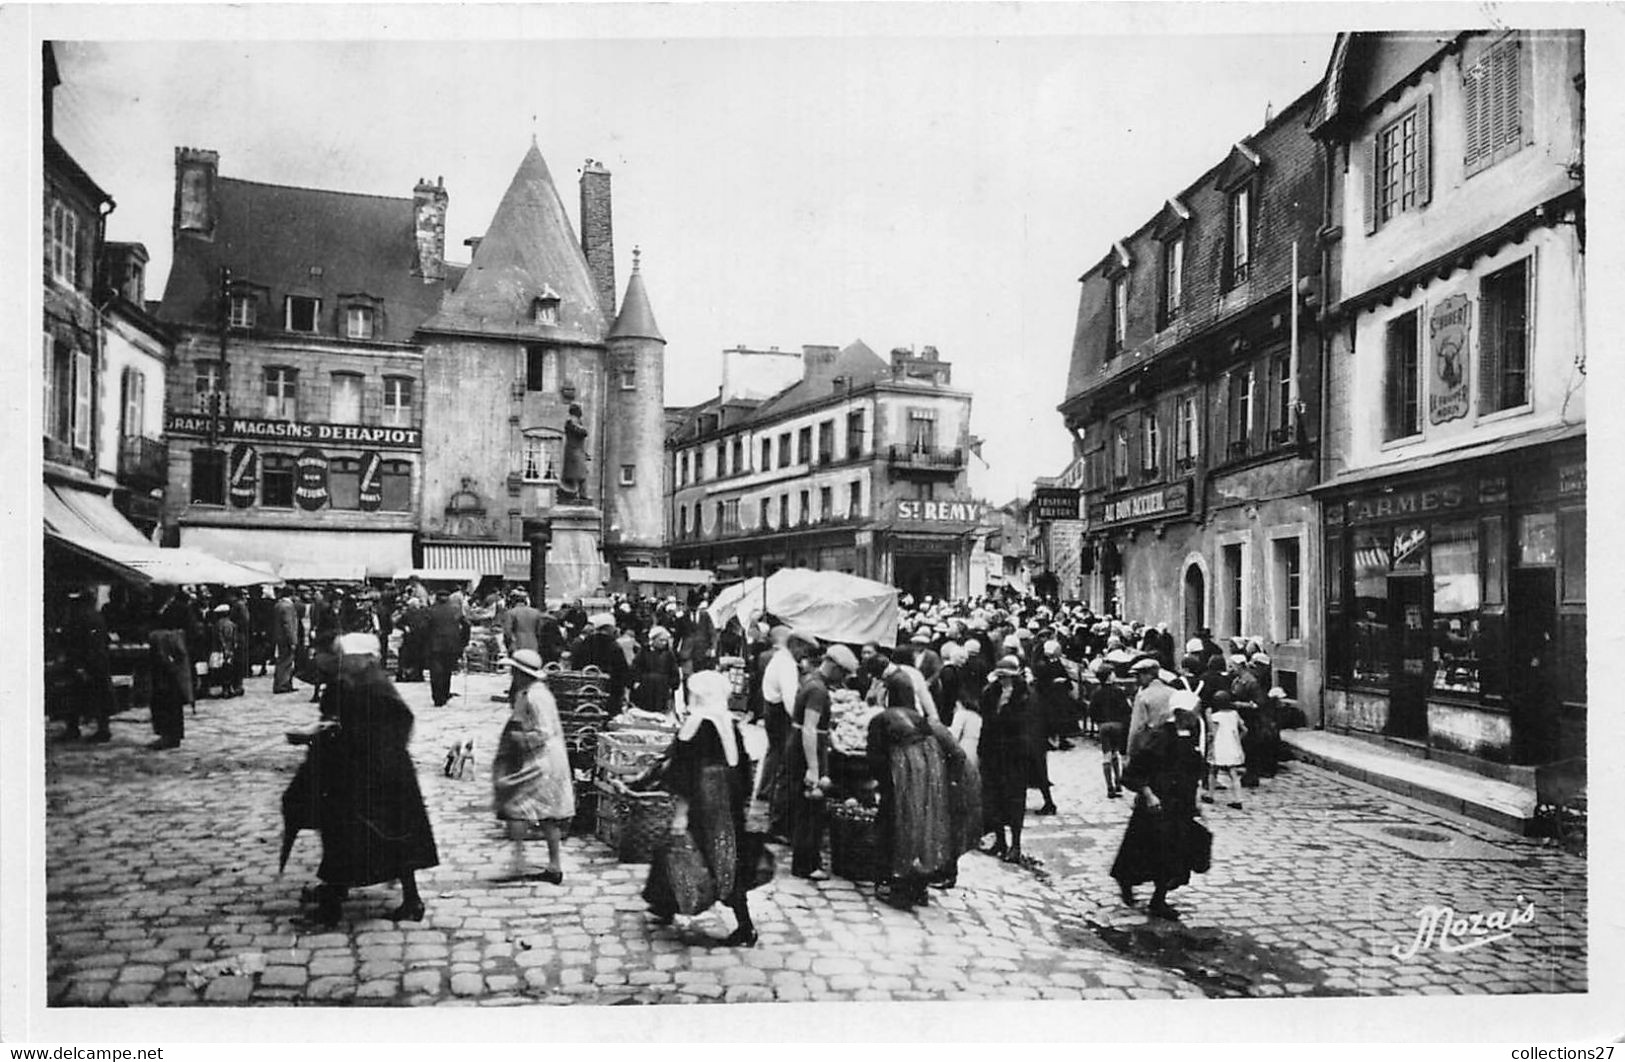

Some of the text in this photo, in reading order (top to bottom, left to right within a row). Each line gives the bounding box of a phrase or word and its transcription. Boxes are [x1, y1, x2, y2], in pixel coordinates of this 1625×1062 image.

[233, 420, 312, 439] MAGASINS
[319, 426, 419, 445] DEHAPIOT
[1116, 499, 1132, 520] BON
[1132, 491, 1165, 517] ACCUEIL
[1353, 484, 1463, 521] ARMES
